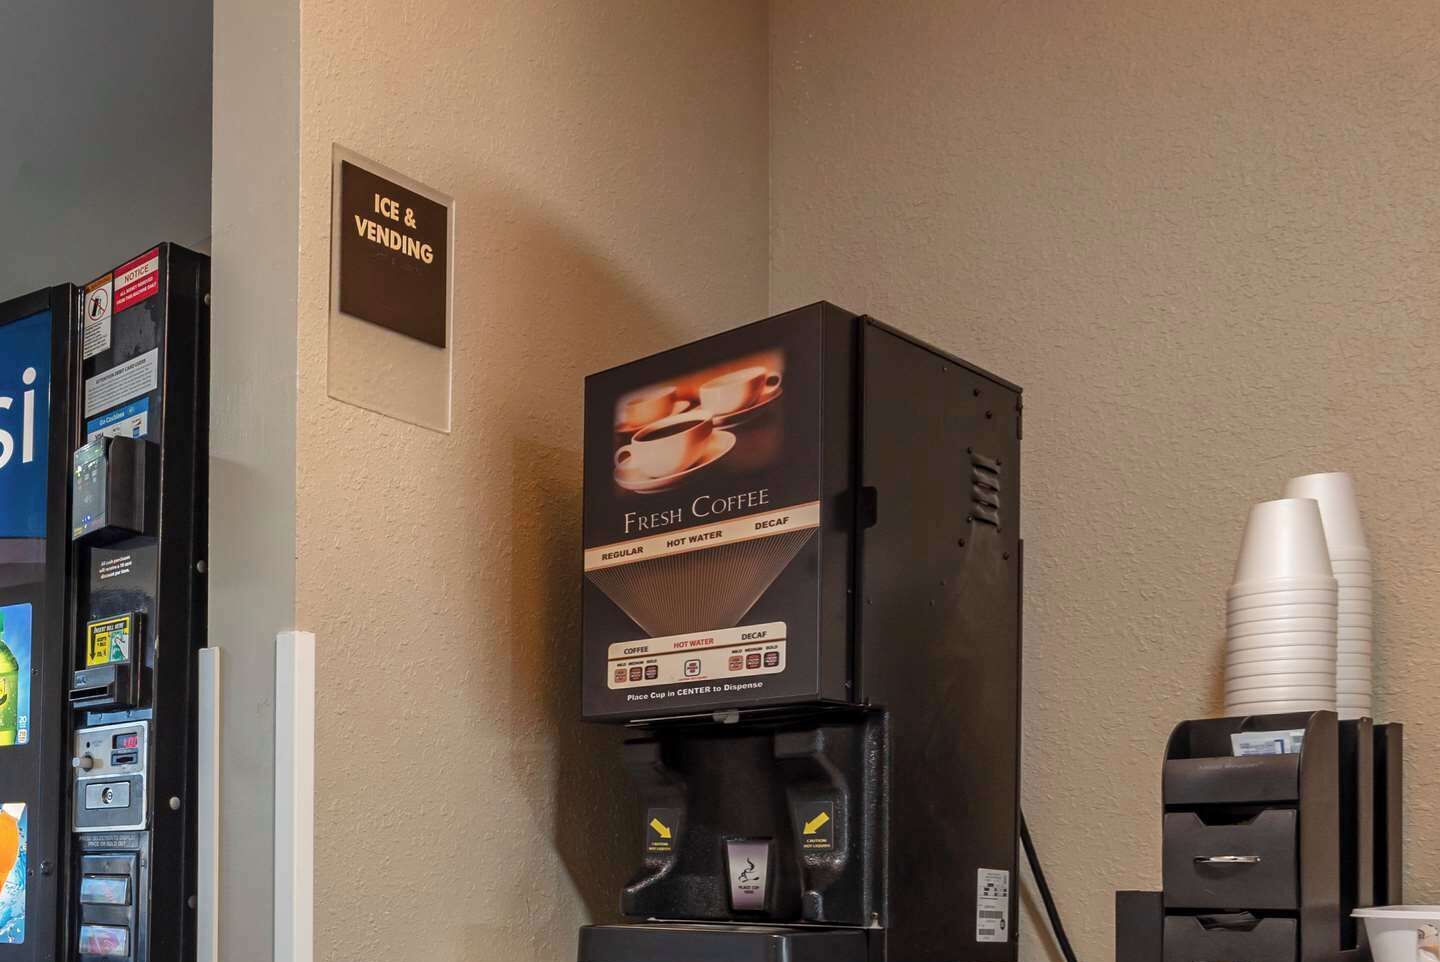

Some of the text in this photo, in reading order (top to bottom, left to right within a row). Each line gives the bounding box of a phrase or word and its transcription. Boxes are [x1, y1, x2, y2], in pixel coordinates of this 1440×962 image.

[374, 193, 417, 230] ICE &
[354, 214, 434, 264] VENDING
[124, 264, 149, 283] NOTICE
[754, 516, 790, 530] DECAF
[666, 530, 723, 548] HOT WATER
[601, 546, 644, 561] REGULAR
[673, 638, 714, 649] HOT WATER
[741, 631, 768, 641] DECAF
[623, 645, 649, 655] COFFEE
[627, 681, 764, 701] Place Cup in CENTER to Dispense
